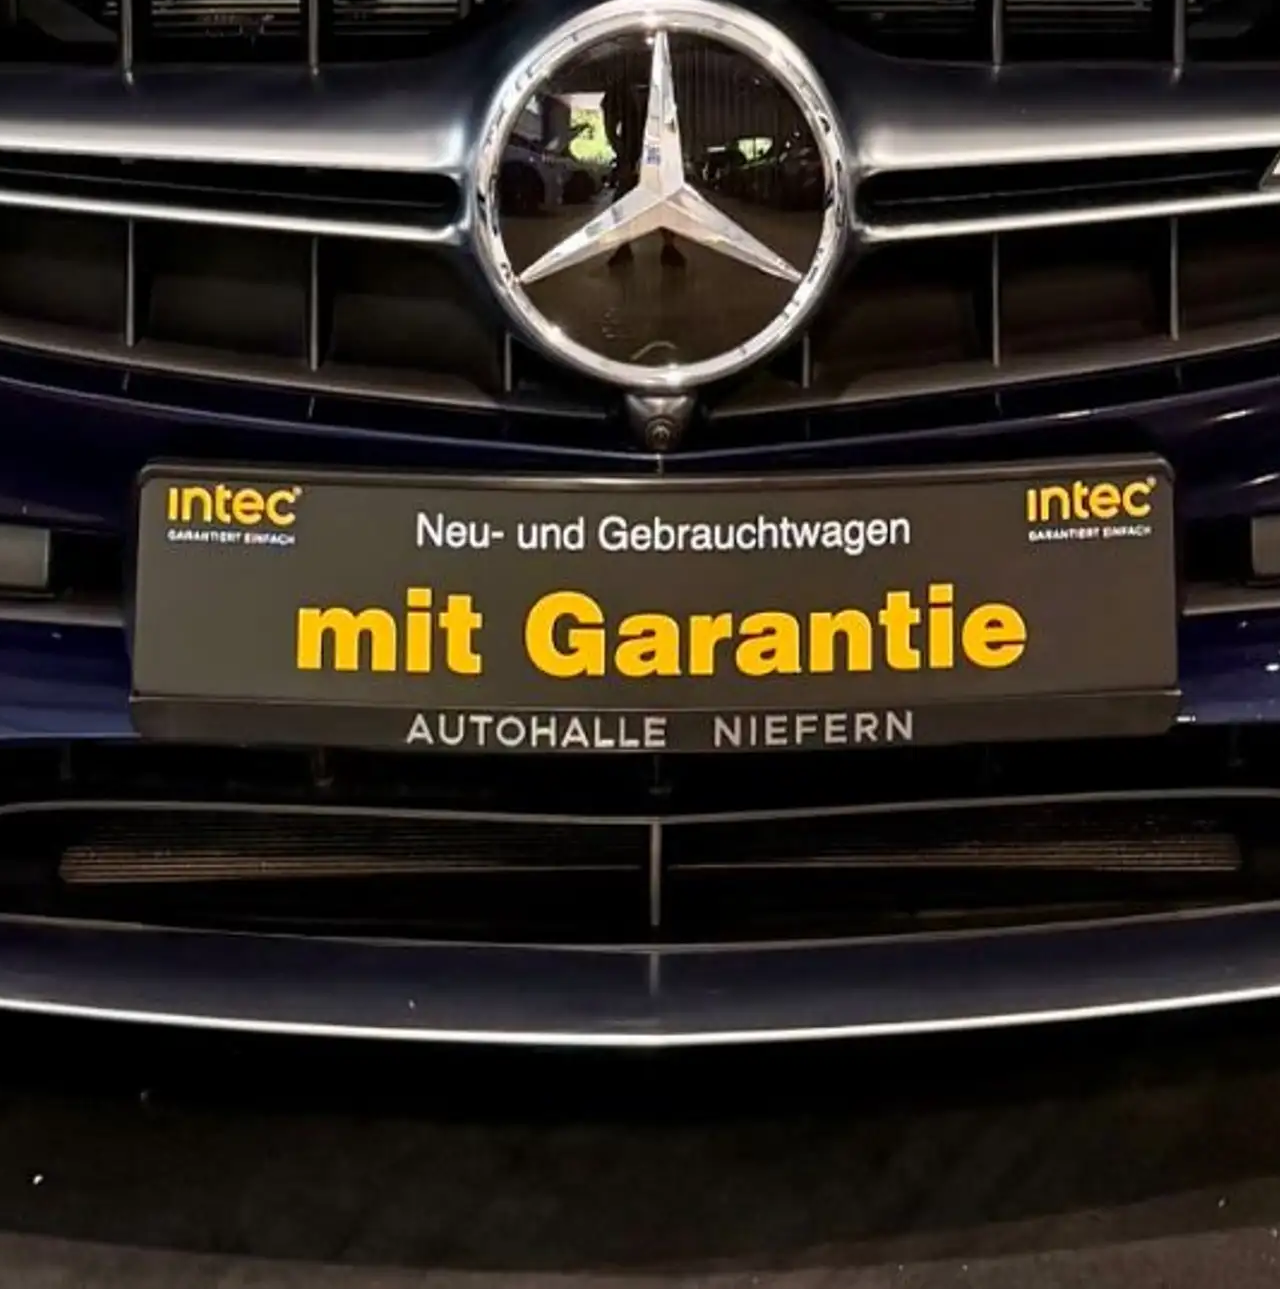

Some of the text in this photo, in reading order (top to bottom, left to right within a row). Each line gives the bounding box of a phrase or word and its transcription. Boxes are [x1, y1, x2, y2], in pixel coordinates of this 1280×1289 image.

[167, 483, 297, 526] intec
[1027, 479, 1151, 522] intec
[415, 511, 912, 555] Neu- und Gebrauchtwagen
[296, 583, 1028, 678] mit Garantie
[405, 710, 914, 749] AUTOHALLE NIEFERN
